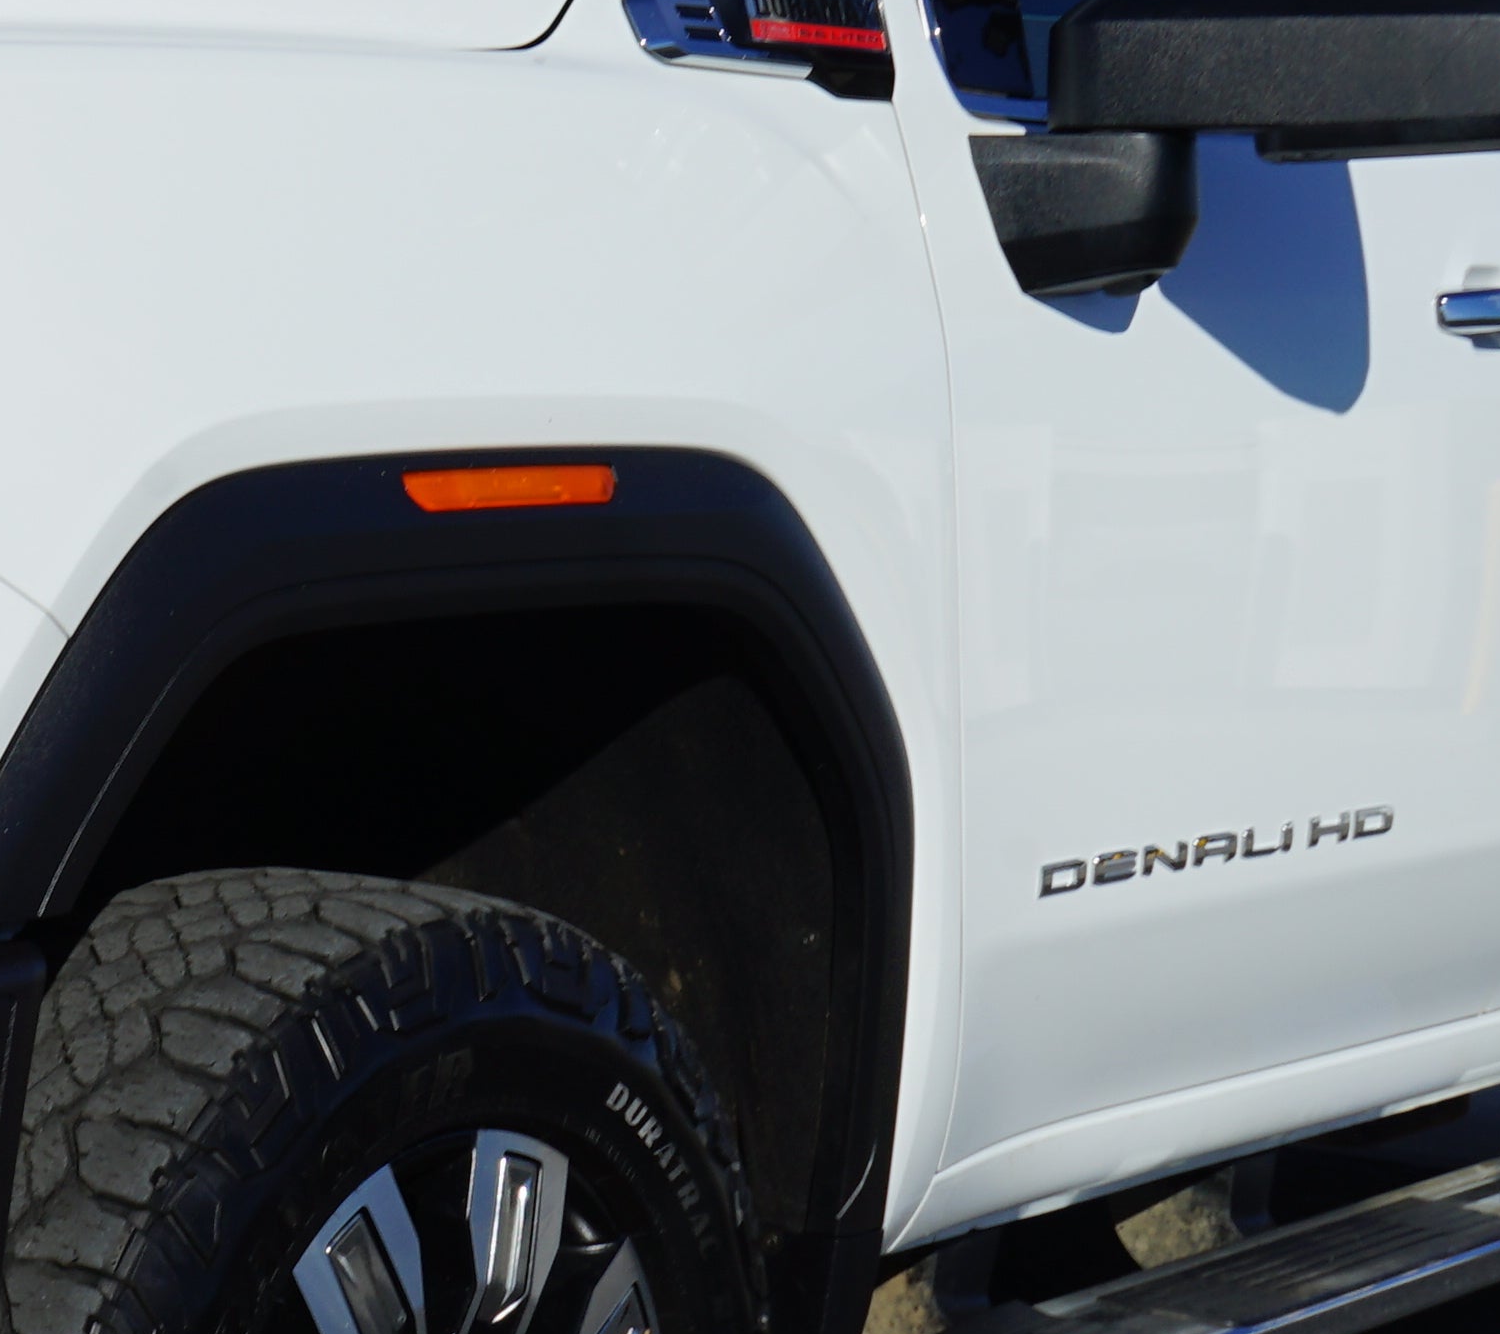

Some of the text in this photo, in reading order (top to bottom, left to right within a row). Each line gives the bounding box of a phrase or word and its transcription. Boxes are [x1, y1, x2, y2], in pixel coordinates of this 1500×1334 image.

[1036, 804, 1396, 899] DENALI HD
[604, 1079, 722, 1264] DURATRAC
